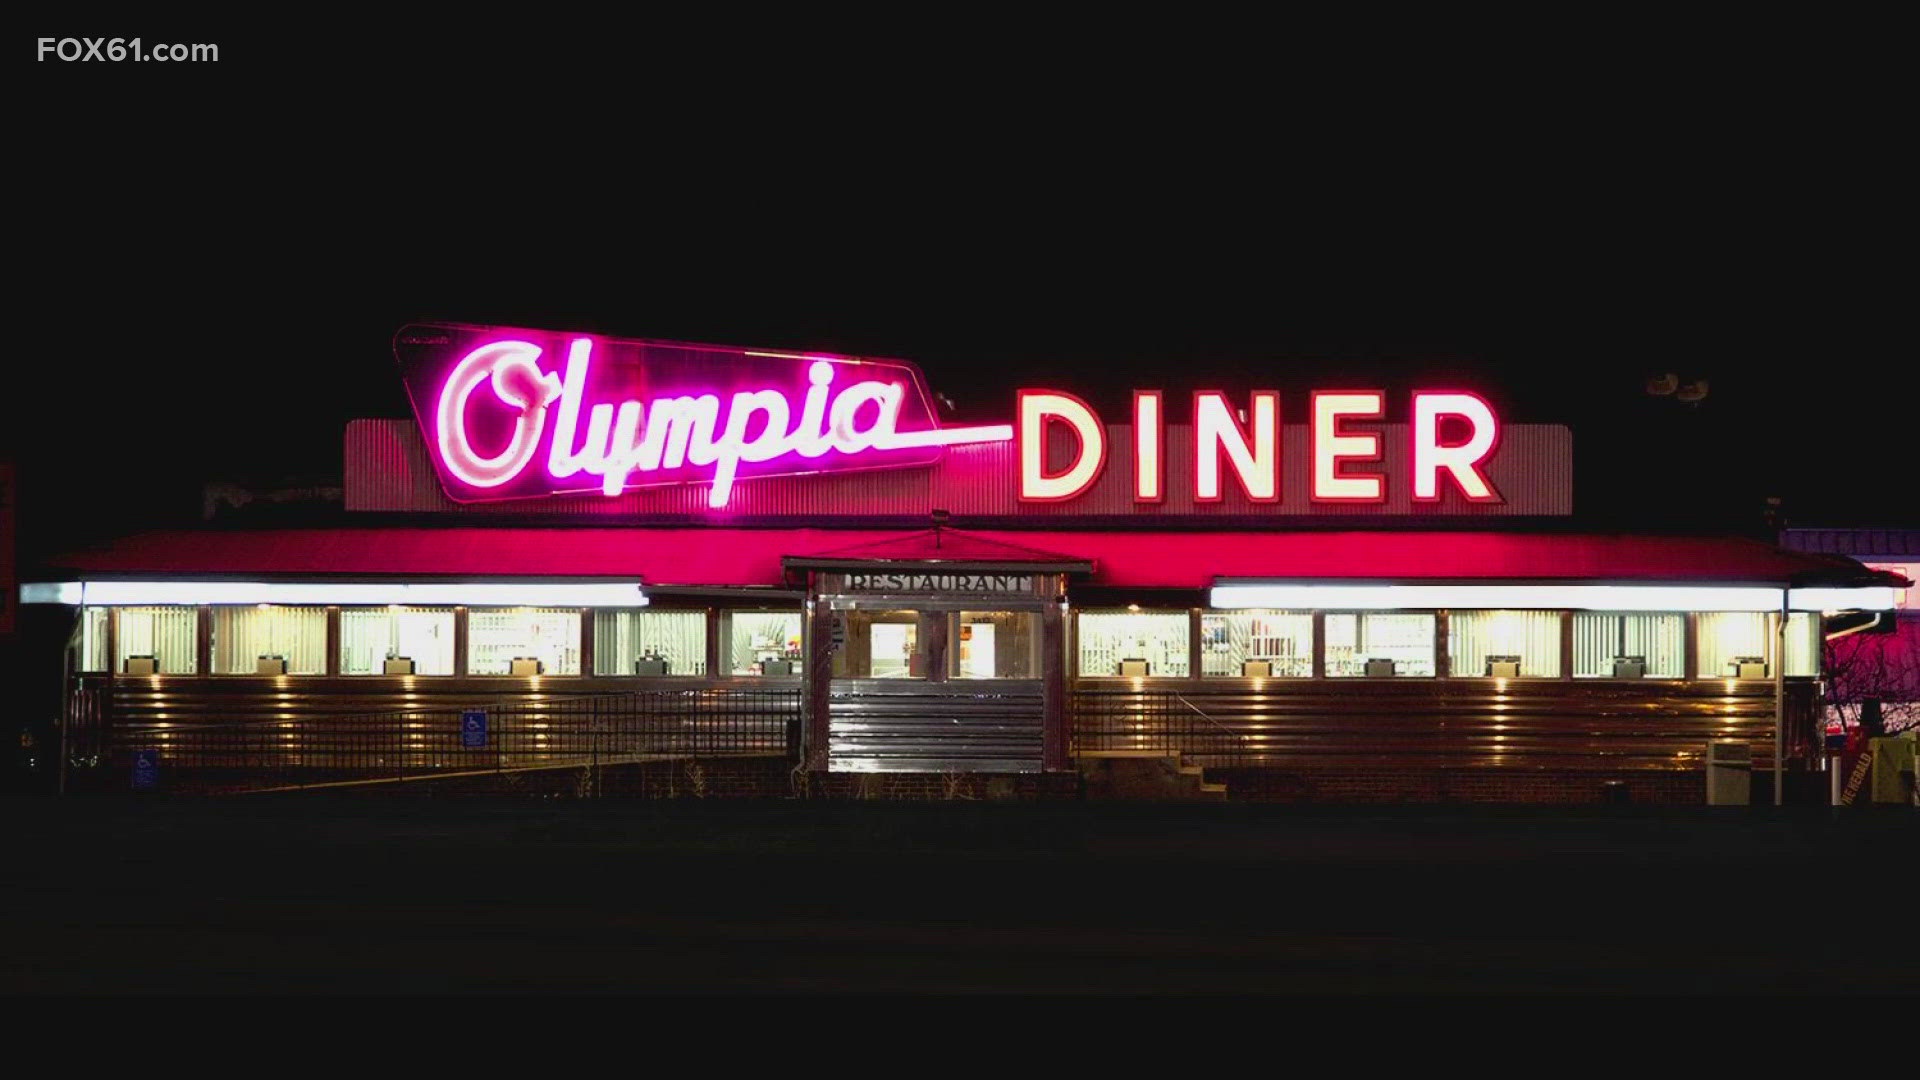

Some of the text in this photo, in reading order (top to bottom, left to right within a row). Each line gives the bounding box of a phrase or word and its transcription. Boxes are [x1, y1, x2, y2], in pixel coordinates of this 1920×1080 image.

[437, 338, 1506, 508] Olympia DINER
[849, 574, 1028, 592] RESTAURANT
